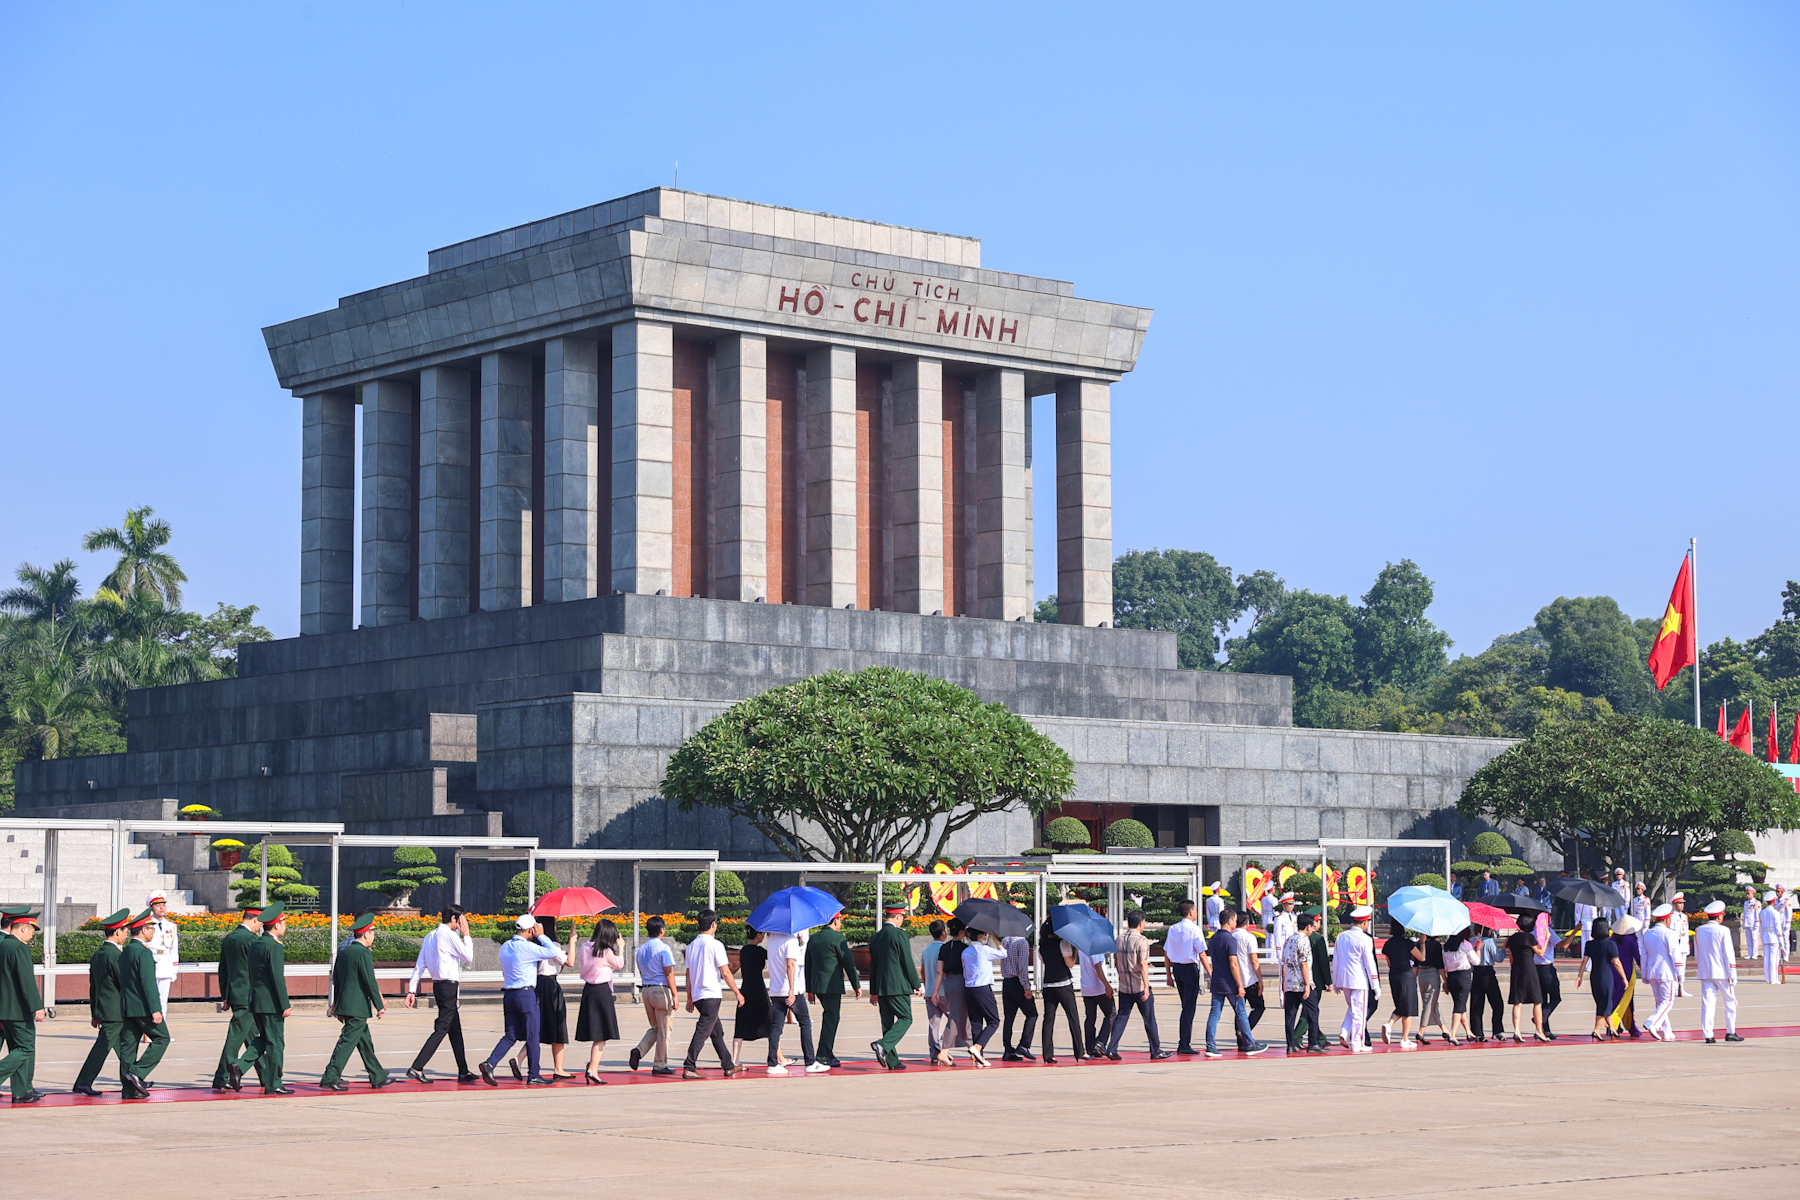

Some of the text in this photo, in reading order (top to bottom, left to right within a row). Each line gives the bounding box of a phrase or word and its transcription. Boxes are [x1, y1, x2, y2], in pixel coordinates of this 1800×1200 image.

[851, 271, 895, 292] CHỦ
[778, 285, 828, 316] HỒ
[854, 297, 911, 328] CHÍ
